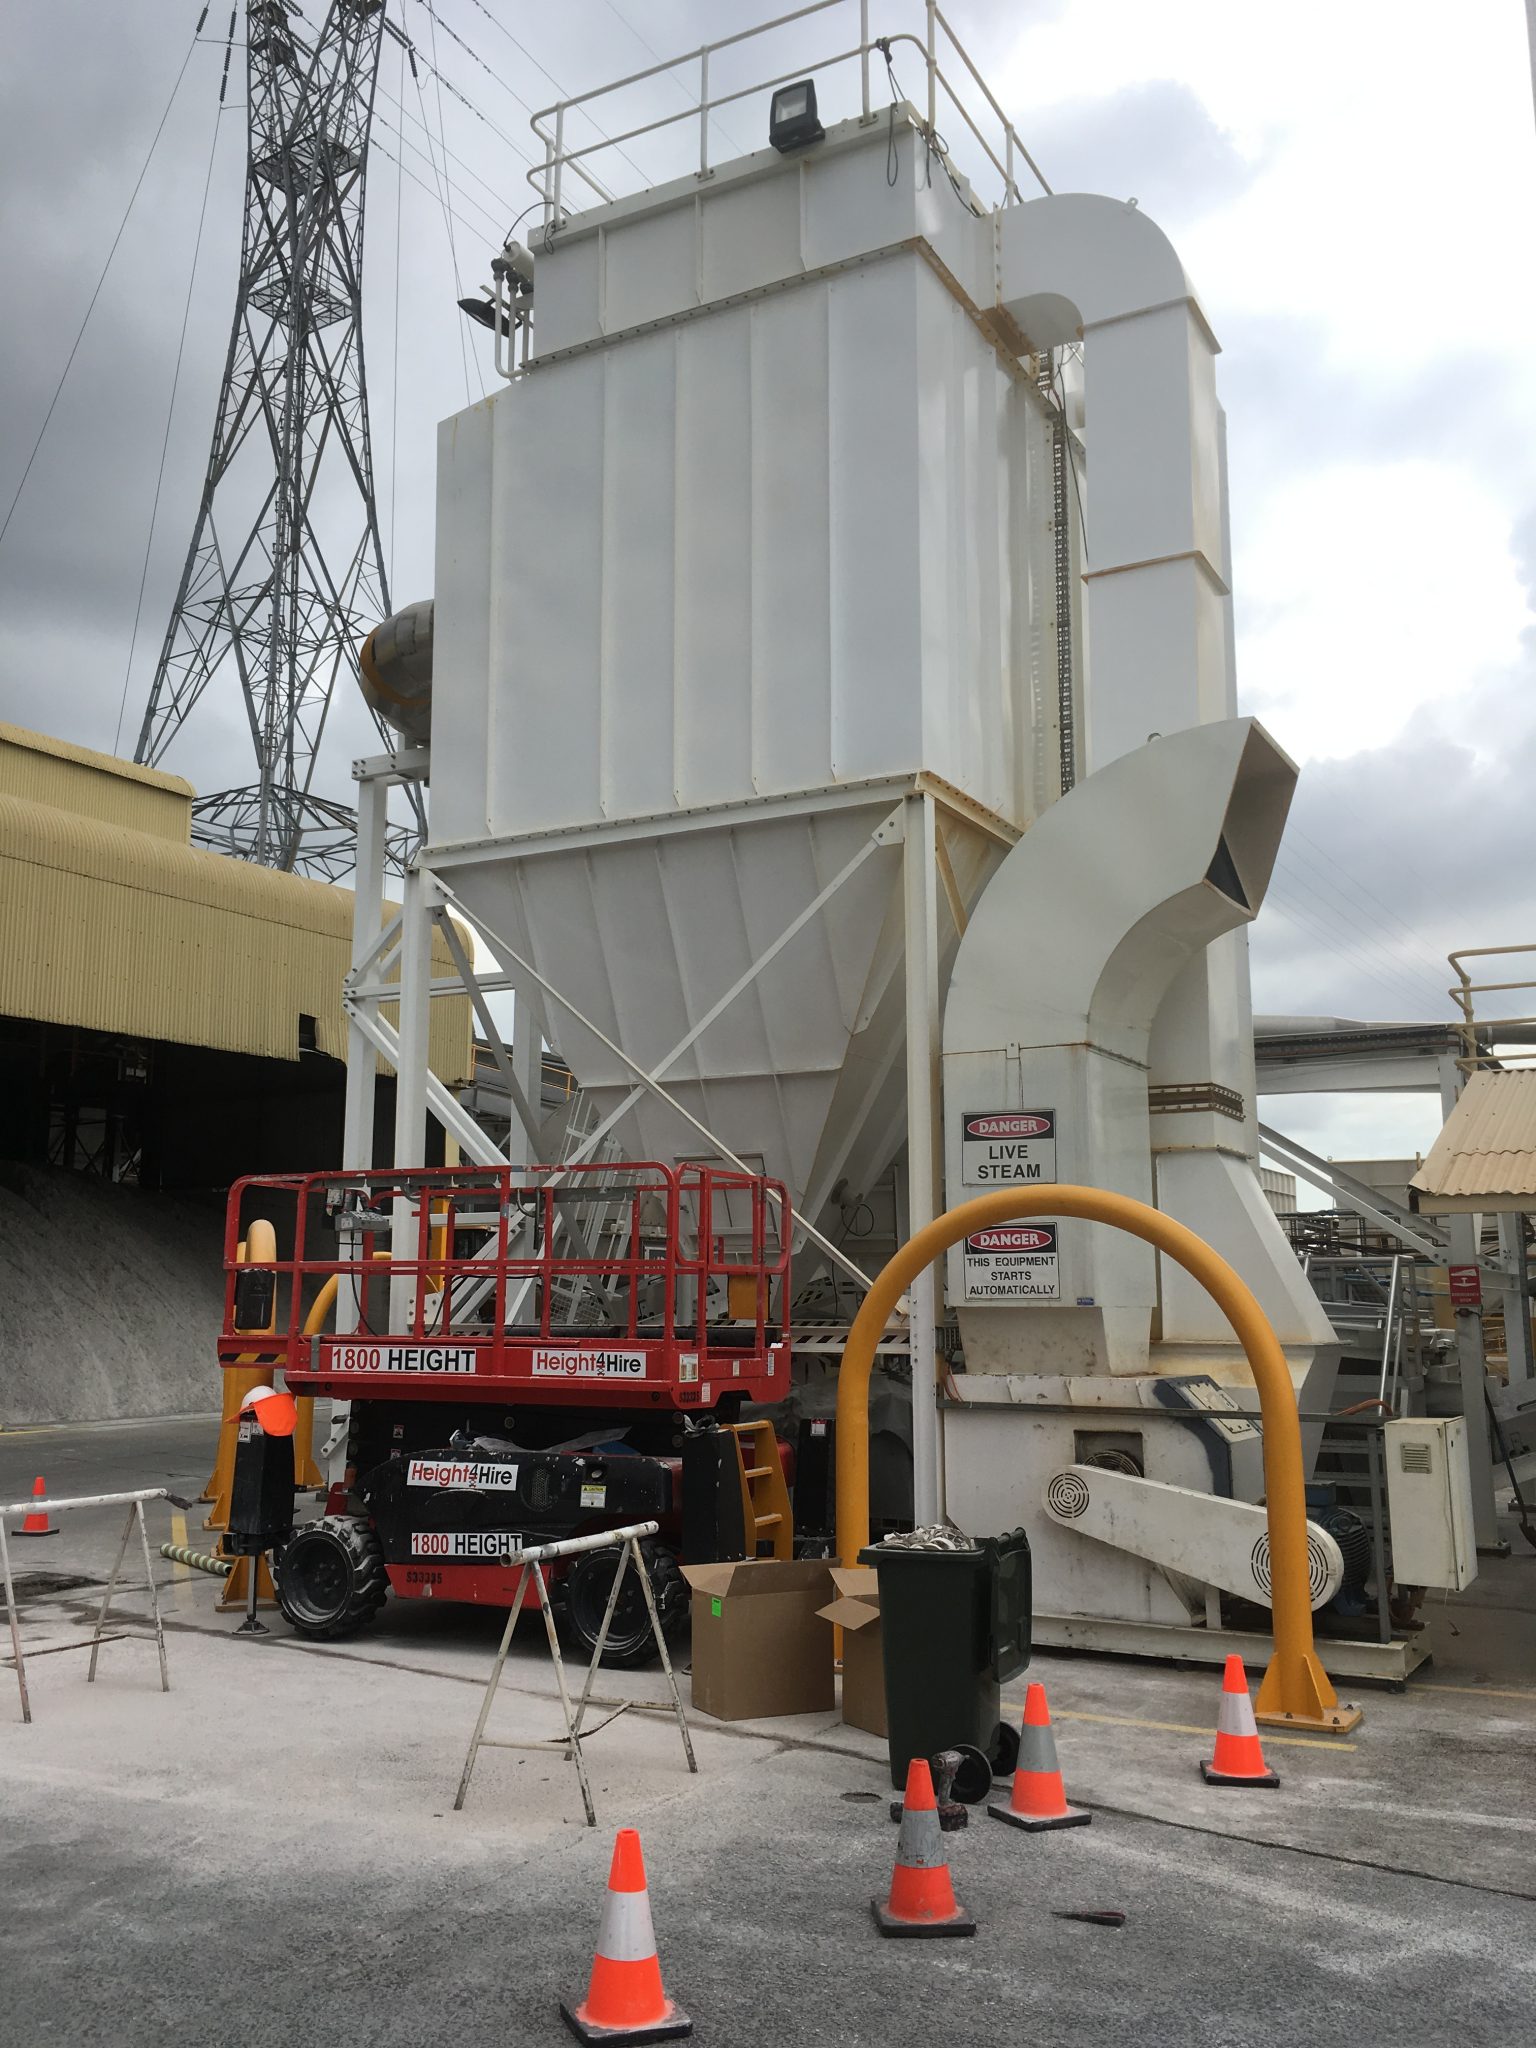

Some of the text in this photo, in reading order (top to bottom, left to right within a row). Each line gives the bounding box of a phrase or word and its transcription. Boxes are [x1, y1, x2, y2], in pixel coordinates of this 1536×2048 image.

[979, 1119, 1038, 1133] DANGER
[989, 1145, 1028, 1160] LIVE
[978, 1163, 1041, 1179] STEAM
[980, 1233, 1040, 1246] DANGER
[967, 1256, 1056, 1267] THIS EQUIPMENT
[990, 1271, 1032, 1281] STARTS
[969, 1285, 1055, 1295] AUTOMATICALLY
[333, 1348, 476, 1371] 1800 HEIGHT
[536, 1352, 642, 1375] Height4Hire
[411, 1462, 513, 1487] Height4Hire
[412, 1534, 522, 1555] 1800 HEIGHT
